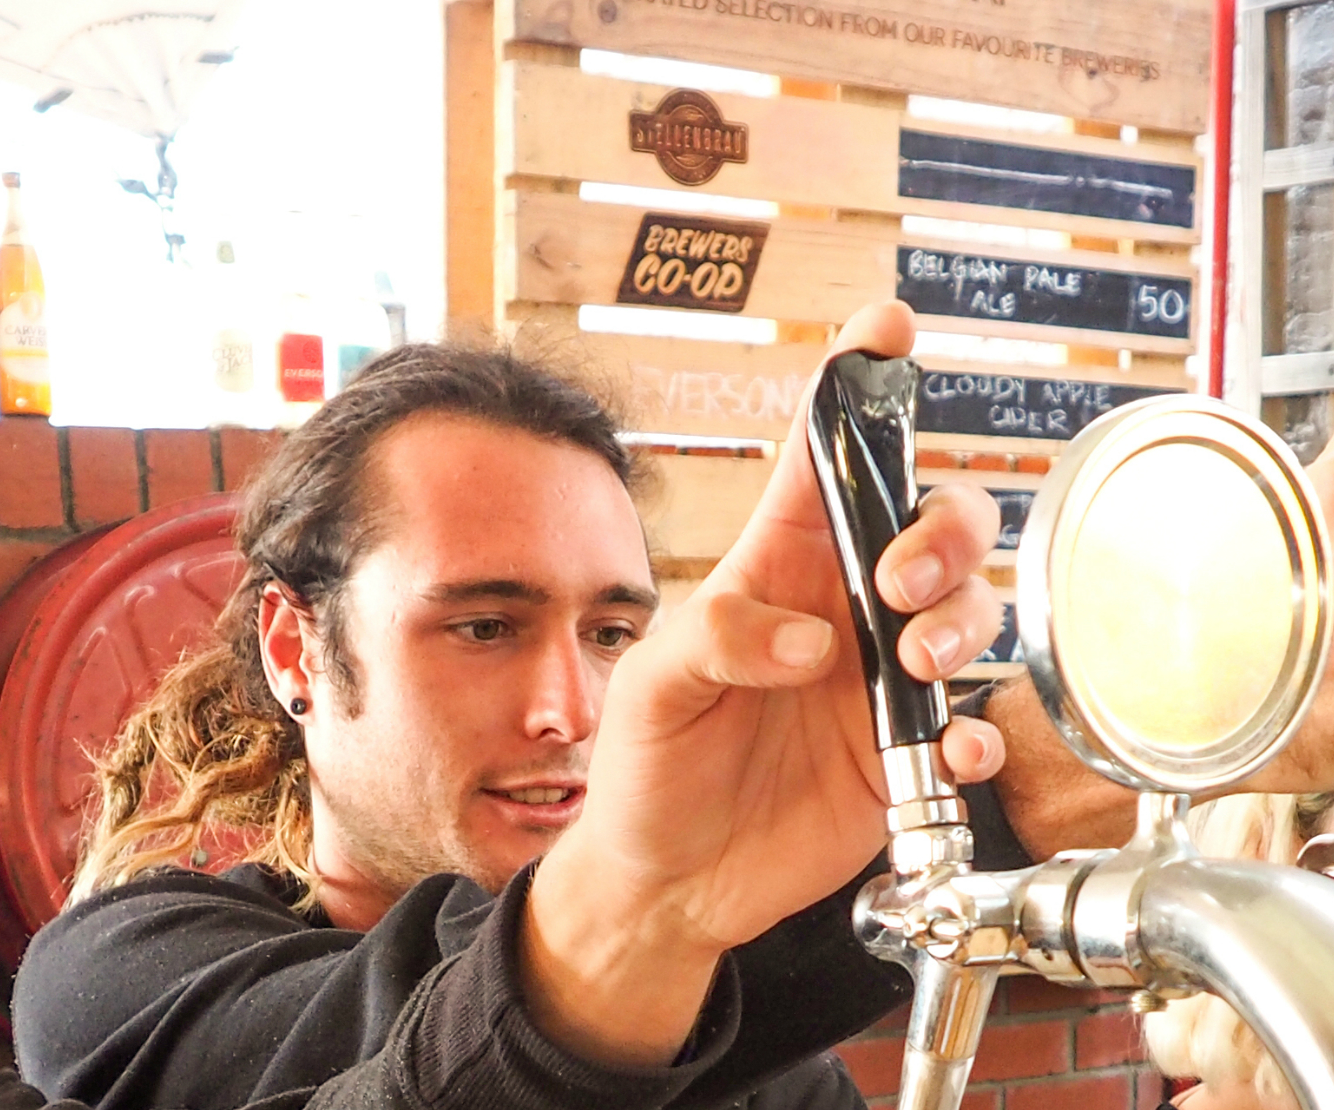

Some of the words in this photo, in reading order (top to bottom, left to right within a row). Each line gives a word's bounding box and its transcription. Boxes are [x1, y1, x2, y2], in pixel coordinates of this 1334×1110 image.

[716, 0, 833, 30] SELECTION
[840, 13, 897, 40] FROM
[903, 21, 947, 47] OUR
[951, 29, 1056, 65] FAVOURITE
[1061, 46, 1162, 82] BREWERIES
[644, 223, 754, 265] BREWERS
[633, 252, 744, 299] CO-OP
[908, 249, 1008, 284] BELGIAN
[1023, 264, 1082, 297] PALE
[969, 289, 1017, 318] ALE
[1137, 284, 1187, 325] 50
[923, 373, 1026, 404] CLOUDY
